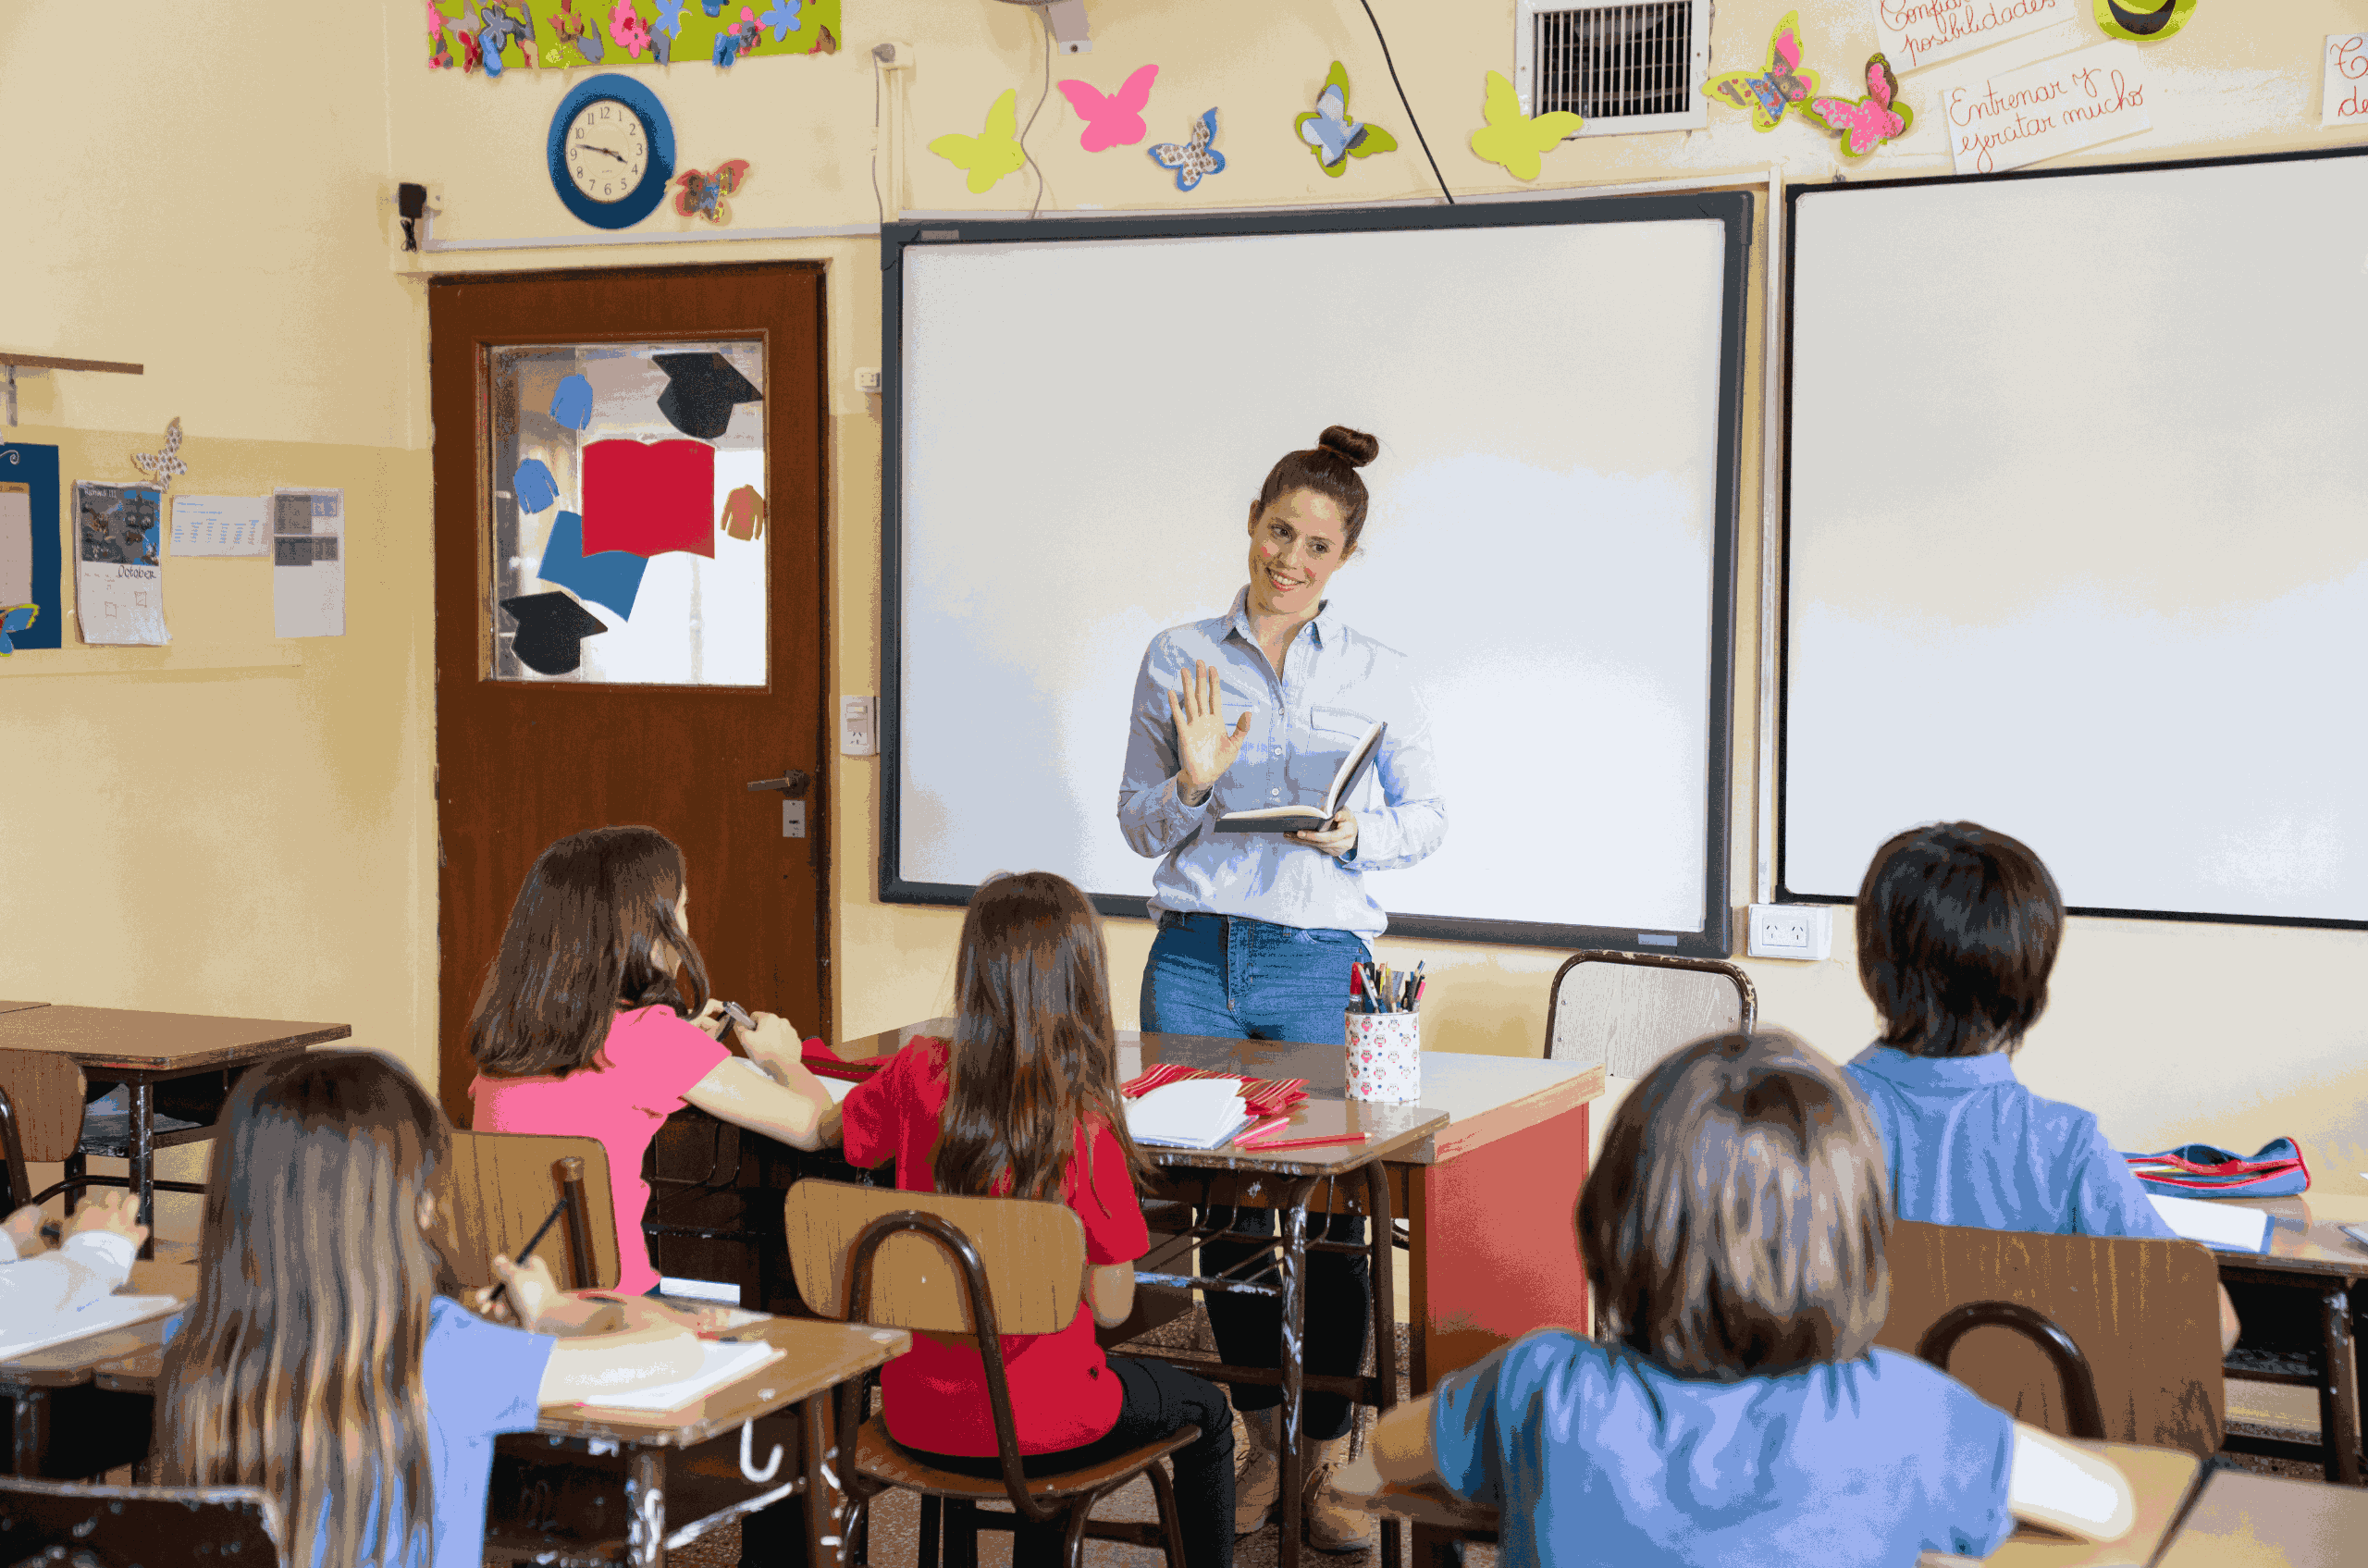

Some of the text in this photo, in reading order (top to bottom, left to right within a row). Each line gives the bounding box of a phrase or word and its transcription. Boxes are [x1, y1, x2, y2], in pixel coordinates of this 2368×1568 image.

[1950, 80, 2067, 126] Entrenar
[2063, 69, 2143, 125] mucho
[587, 112, 595, 125] 11
[600, 106, 610, 119] 12
[618, 109, 623, 122] 1
[575, 128, 585, 140] 10
[629, 123, 636, 136] 2
[570, 148, 577, 161] 9
[635, 143, 643, 156] 3
[576, 167, 584, 179] 8
[631, 164, 638, 175] 4
[588, 179, 597, 191] 7
[604, 183, 611, 195] 6
[621, 178, 627, 191] 5
